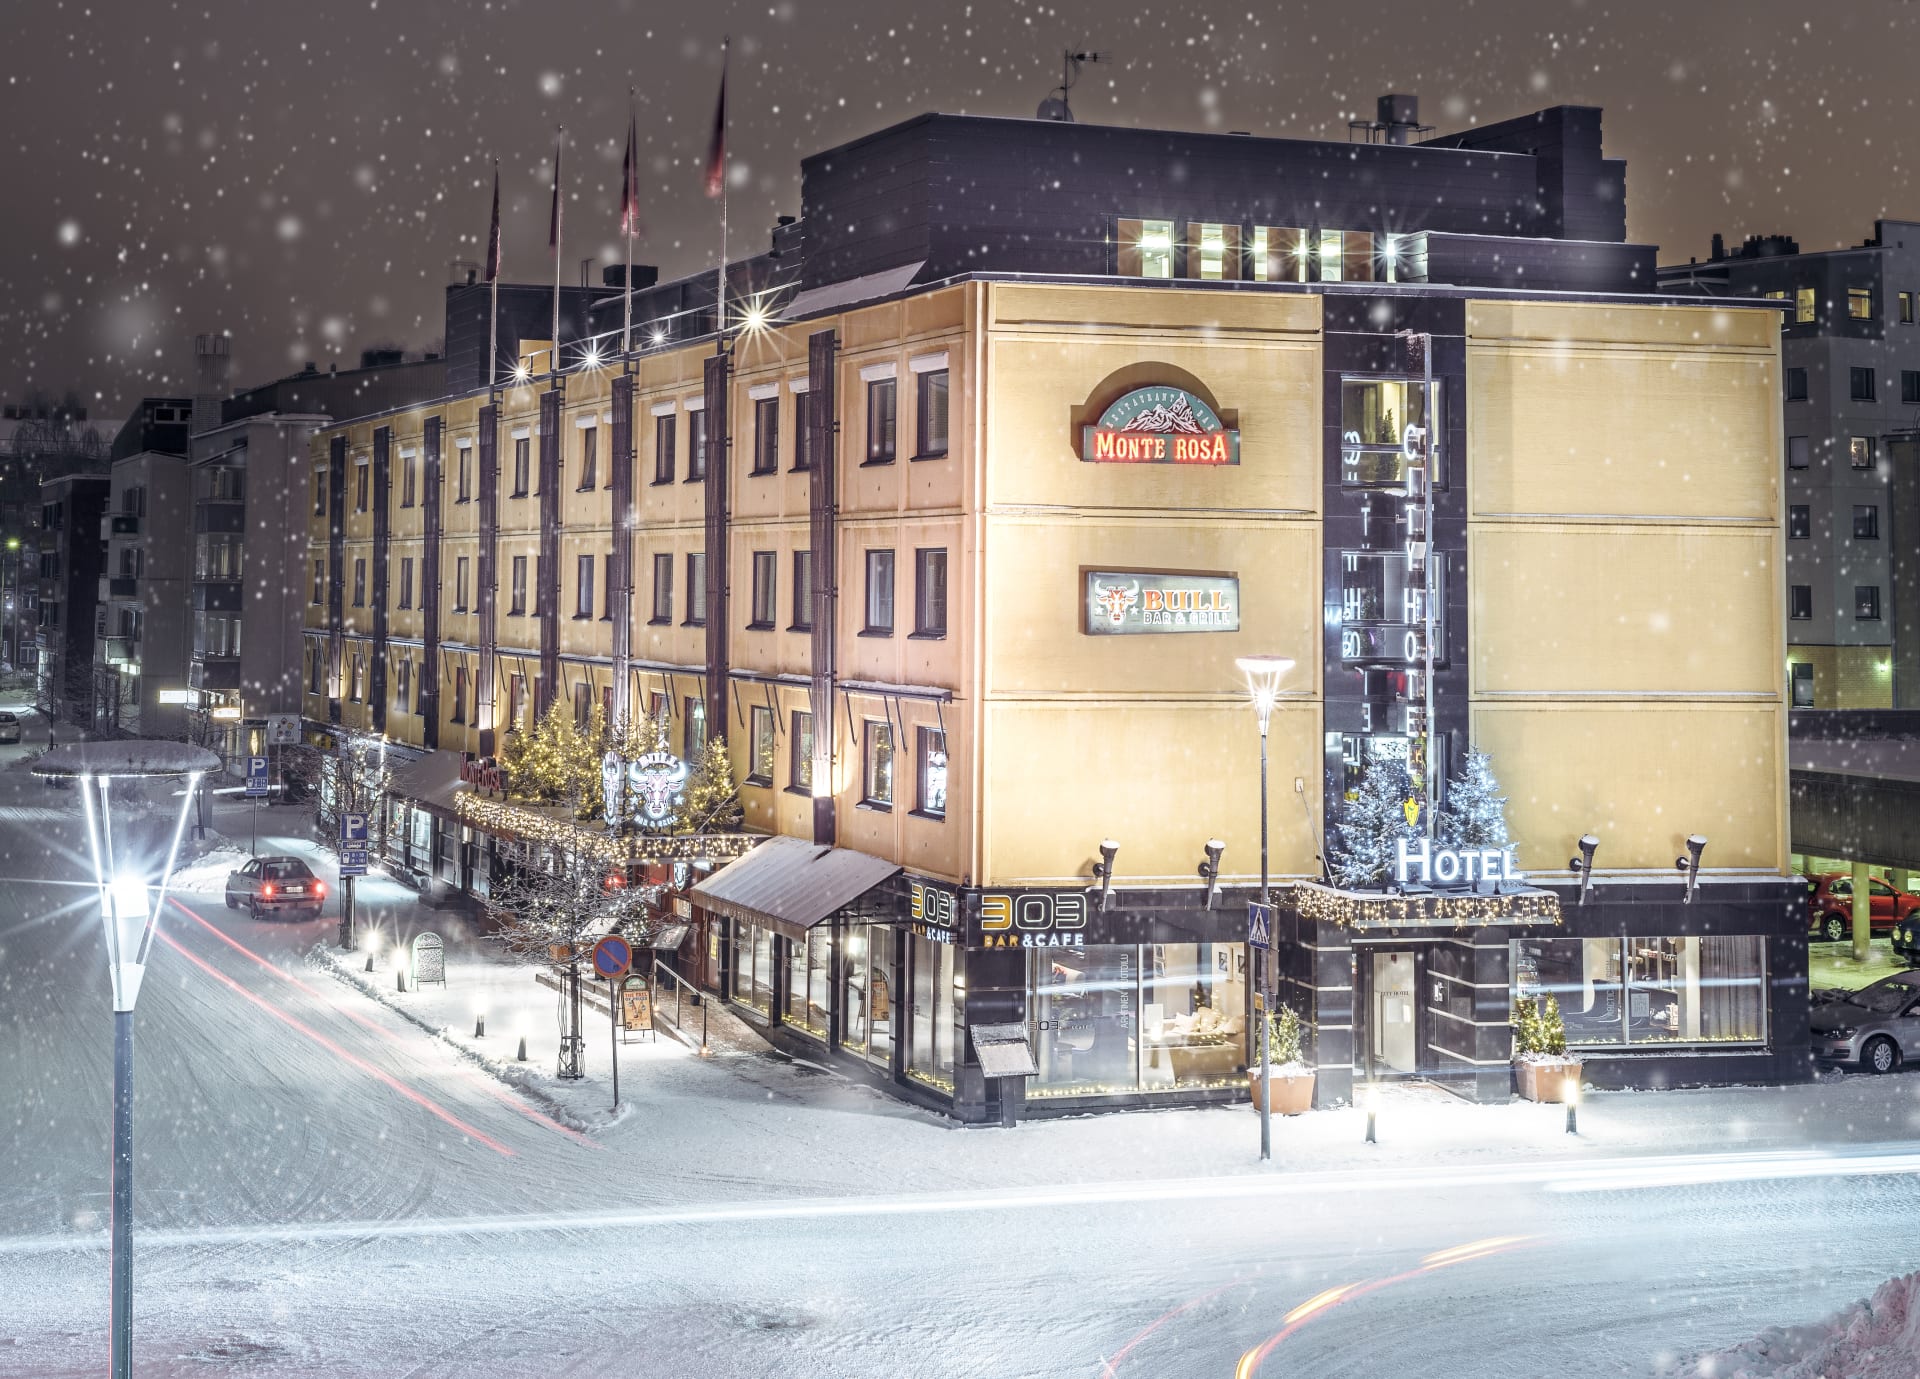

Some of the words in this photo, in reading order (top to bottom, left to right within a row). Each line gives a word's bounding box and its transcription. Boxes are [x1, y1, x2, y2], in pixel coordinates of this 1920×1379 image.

[1105, 391, 1175, 429] RESTAURANT
[1196, 409, 1215, 431] BAR
[1096, 432, 1166, 459] MONTE
[1175, 434, 1228, 461] ROSA
[1142, 588, 1231, 612] BULL
[1143, 611, 1172, 625] BAR
[1175, 612, 1187, 625] &
[1189, 611, 1231, 625] GRILL
[251, 758, 266, 776] P
[637, 752, 679, 769] BULL
[346, 815, 364, 839] P
[911, 883, 951, 928] 303
[981, 893, 1087, 931] 303
[983, 934, 1019, 948] BAR
